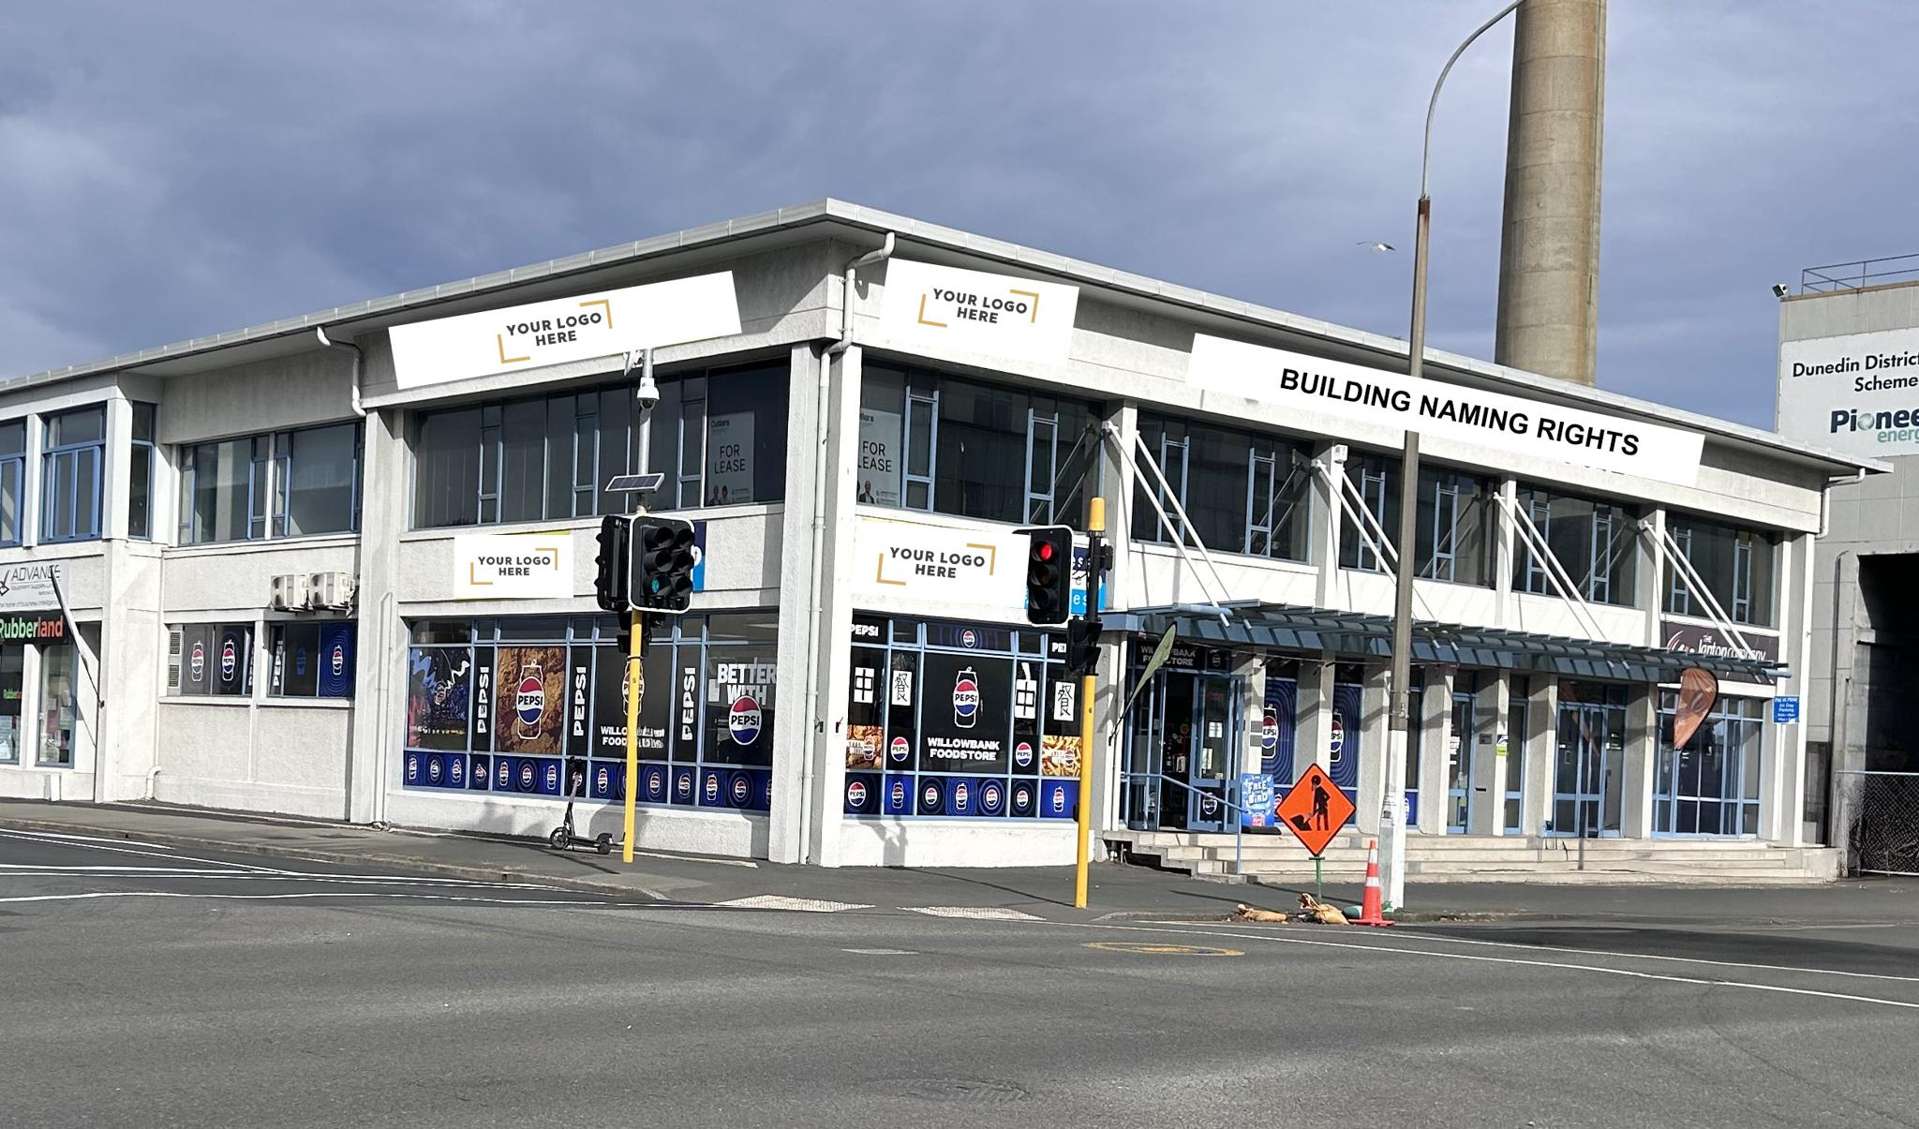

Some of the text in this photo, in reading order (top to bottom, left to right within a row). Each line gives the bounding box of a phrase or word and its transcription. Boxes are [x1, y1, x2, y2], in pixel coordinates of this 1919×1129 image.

[933, 288, 1028, 315] YOUR LOGO
[957, 306, 999, 324] HERE
[506, 312, 602, 336] YOUR LOGO
[535, 330, 577, 347] HERE
[1793, 357, 1860, 377] Dunedin
[1854, 375, 1919, 392] Scheme
[1280, 368, 1640, 456] BUILDING NAMING RIGHTS
[719, 444, 740, 460] FOR
[863, 441, 886, 457] FOR
[714, 458, 746, 474] LEASE
[478, 556, 551, 566] YOUR LOGO
[890, 547, 985, 567] YOUR LOGO
[498, 567, 530, 576] HERE
[915, 563, 957, 579] HERE
[851, 624, 879, 637] PEPSI
[717, 663, 777, 684] BETTER
[854, 666, 874, 704] 中
[477, 666, 490, 734] PEPSI
[518, 695, 544, 706] PEPSI
[573, 666, 587, 737] PEPSI
[727, 684, 767, 705] WITH
[955, 694, 978, 703] PEPSI
[1015, 680, 1036, 717] 中
[681, 667, 696, 741] PEPSI
[730, 714, 761, 726] PEPSI
[927, 737, 1000, 751] WILLOWBANK
[929, 748, 997, 761] FOODSTORE
